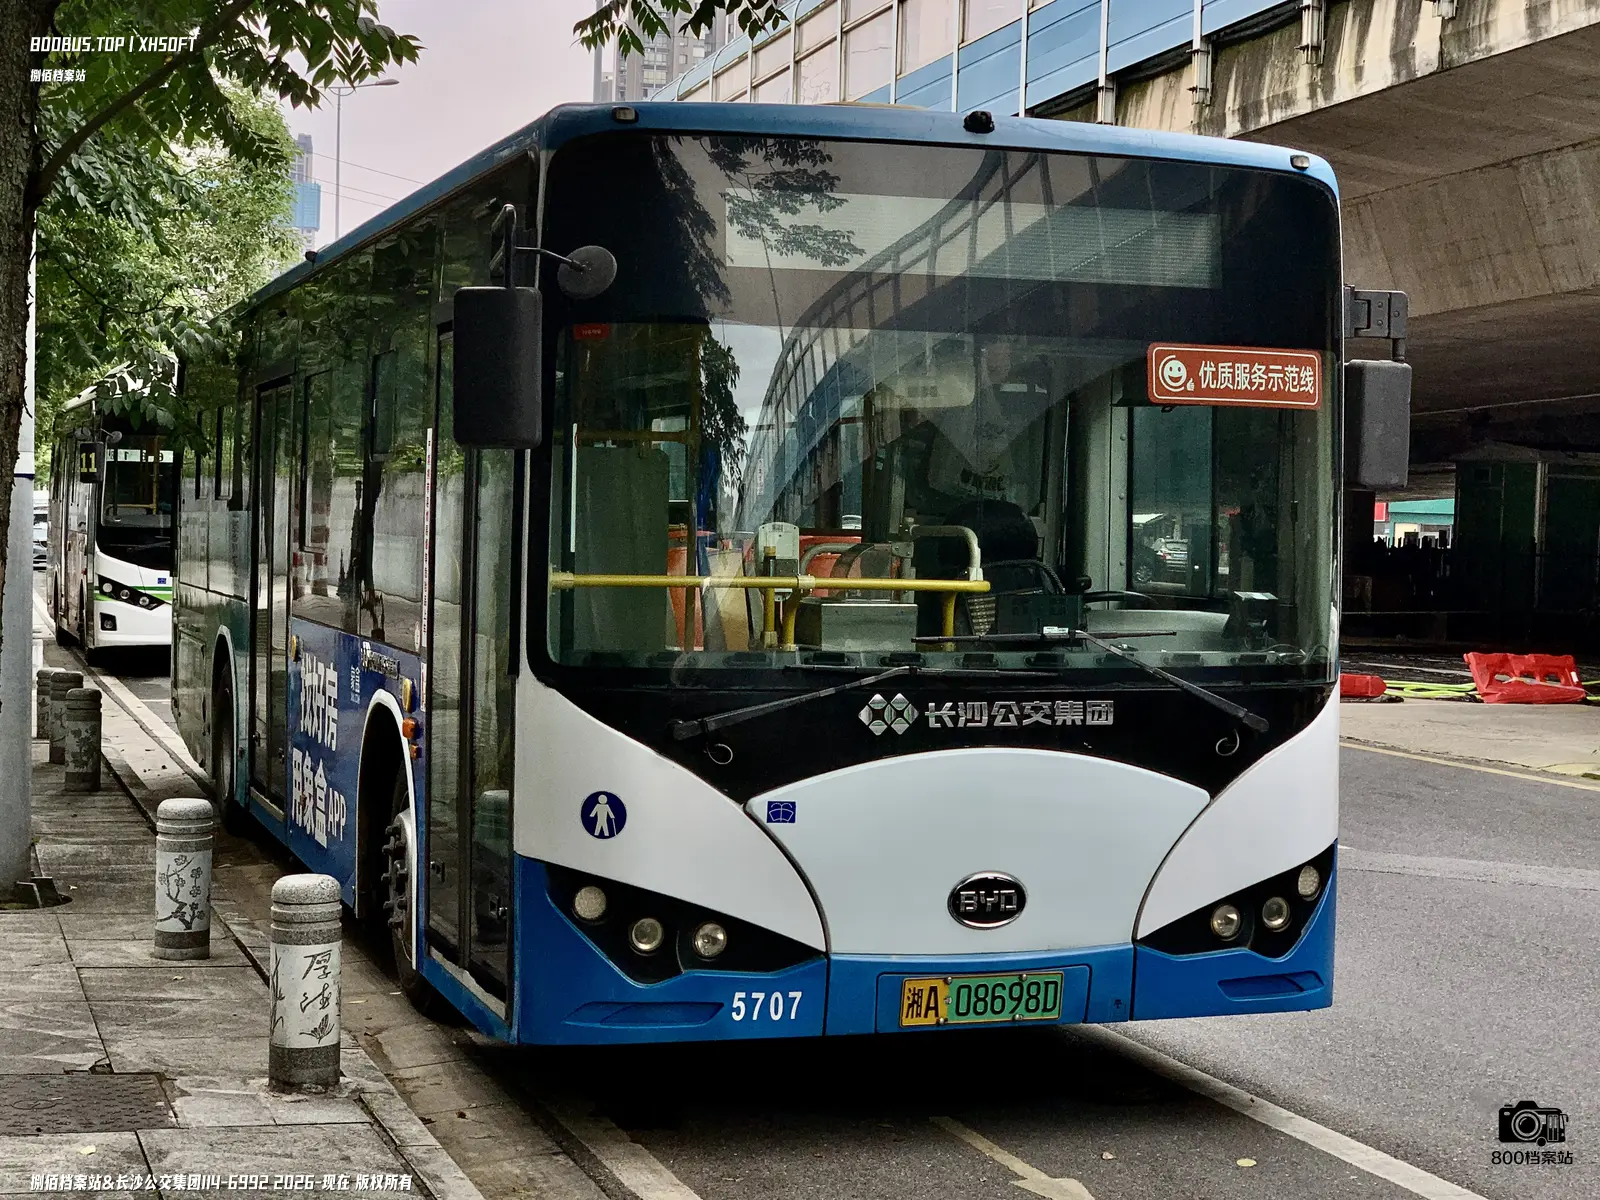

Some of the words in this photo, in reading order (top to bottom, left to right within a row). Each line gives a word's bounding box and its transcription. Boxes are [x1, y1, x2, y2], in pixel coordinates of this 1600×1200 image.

[1199, 360, 1315, 394] 优质服务示范线
[80, 452, 97, 473] 11
[300, 652, 338, 752] 找好房
[924, 700, 1115, 729] 长沙公交集团
[958, 888, 1018, 913] BYD
[731, 990, 803, 1021] 5707
